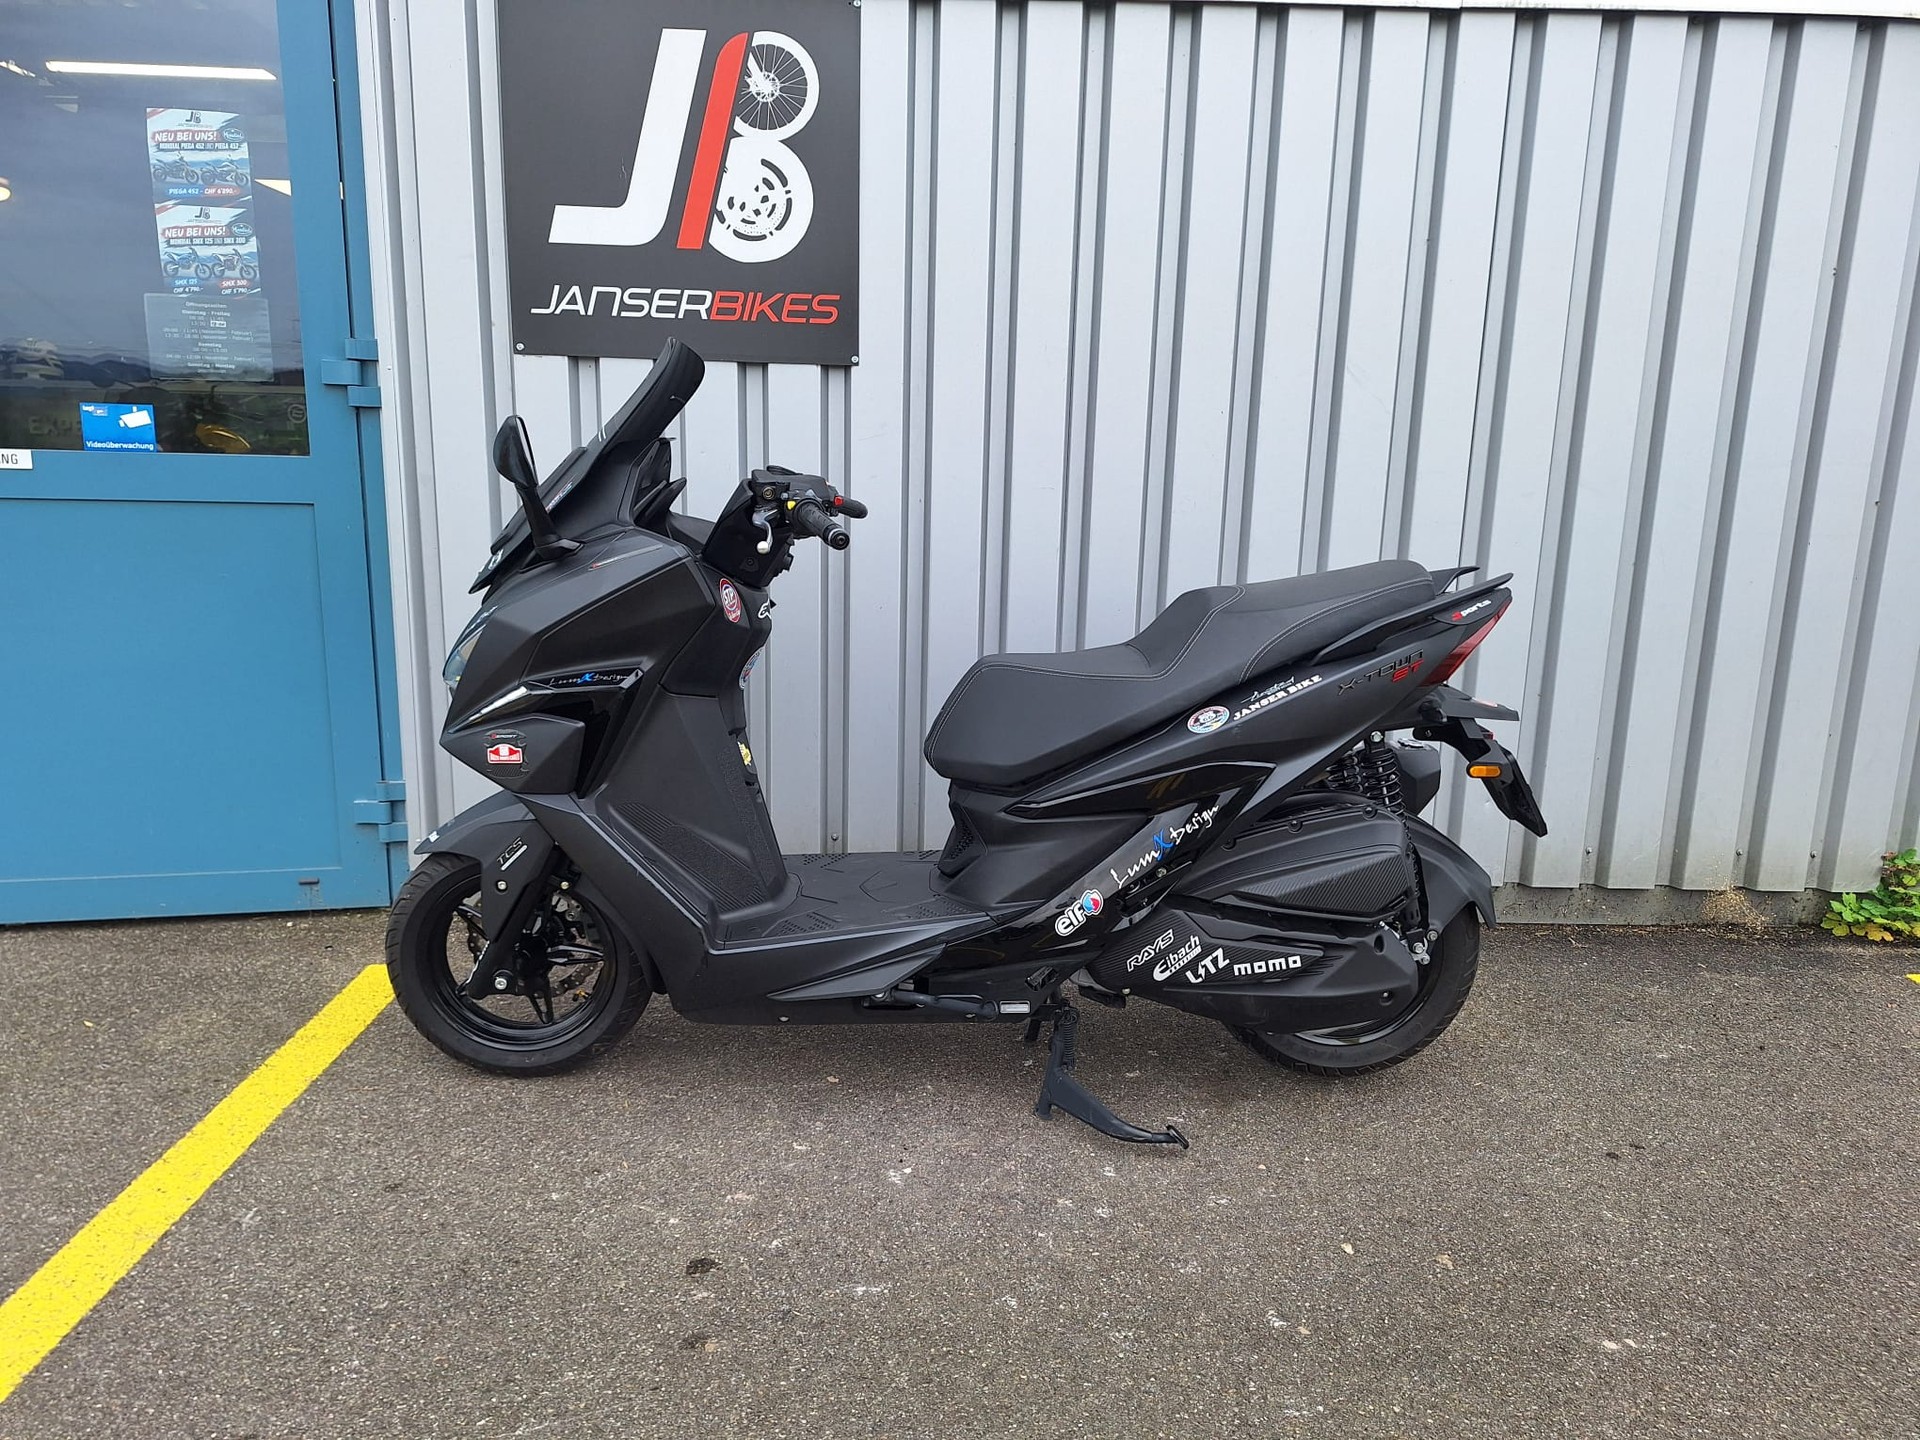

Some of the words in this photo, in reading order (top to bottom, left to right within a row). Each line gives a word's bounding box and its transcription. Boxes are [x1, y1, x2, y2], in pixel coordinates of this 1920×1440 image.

[154, 131, 174, 142] NEU
[176, 132, 192, 141] BEI
[194, 131, 217, 141] UNS!
[165, 228, 184, 238] NEU
[186, 227, 201, 237] BEI
[204, 226, 225, 236] UNS!
[531, 284, 841, 325] JANSERBIKES
[86, 440, 154, 451] Videoüberwachung
[1233, 688, 1289, 721] JANSER
[1286, 674, 1323, 695] BIKE
[496, 836, 523, 865] TCS
[1126, 928, 1175, 972] RAYS
[1153, 934, 1202, 982] Eibach
[1233, 955, 1302, 976] momo
